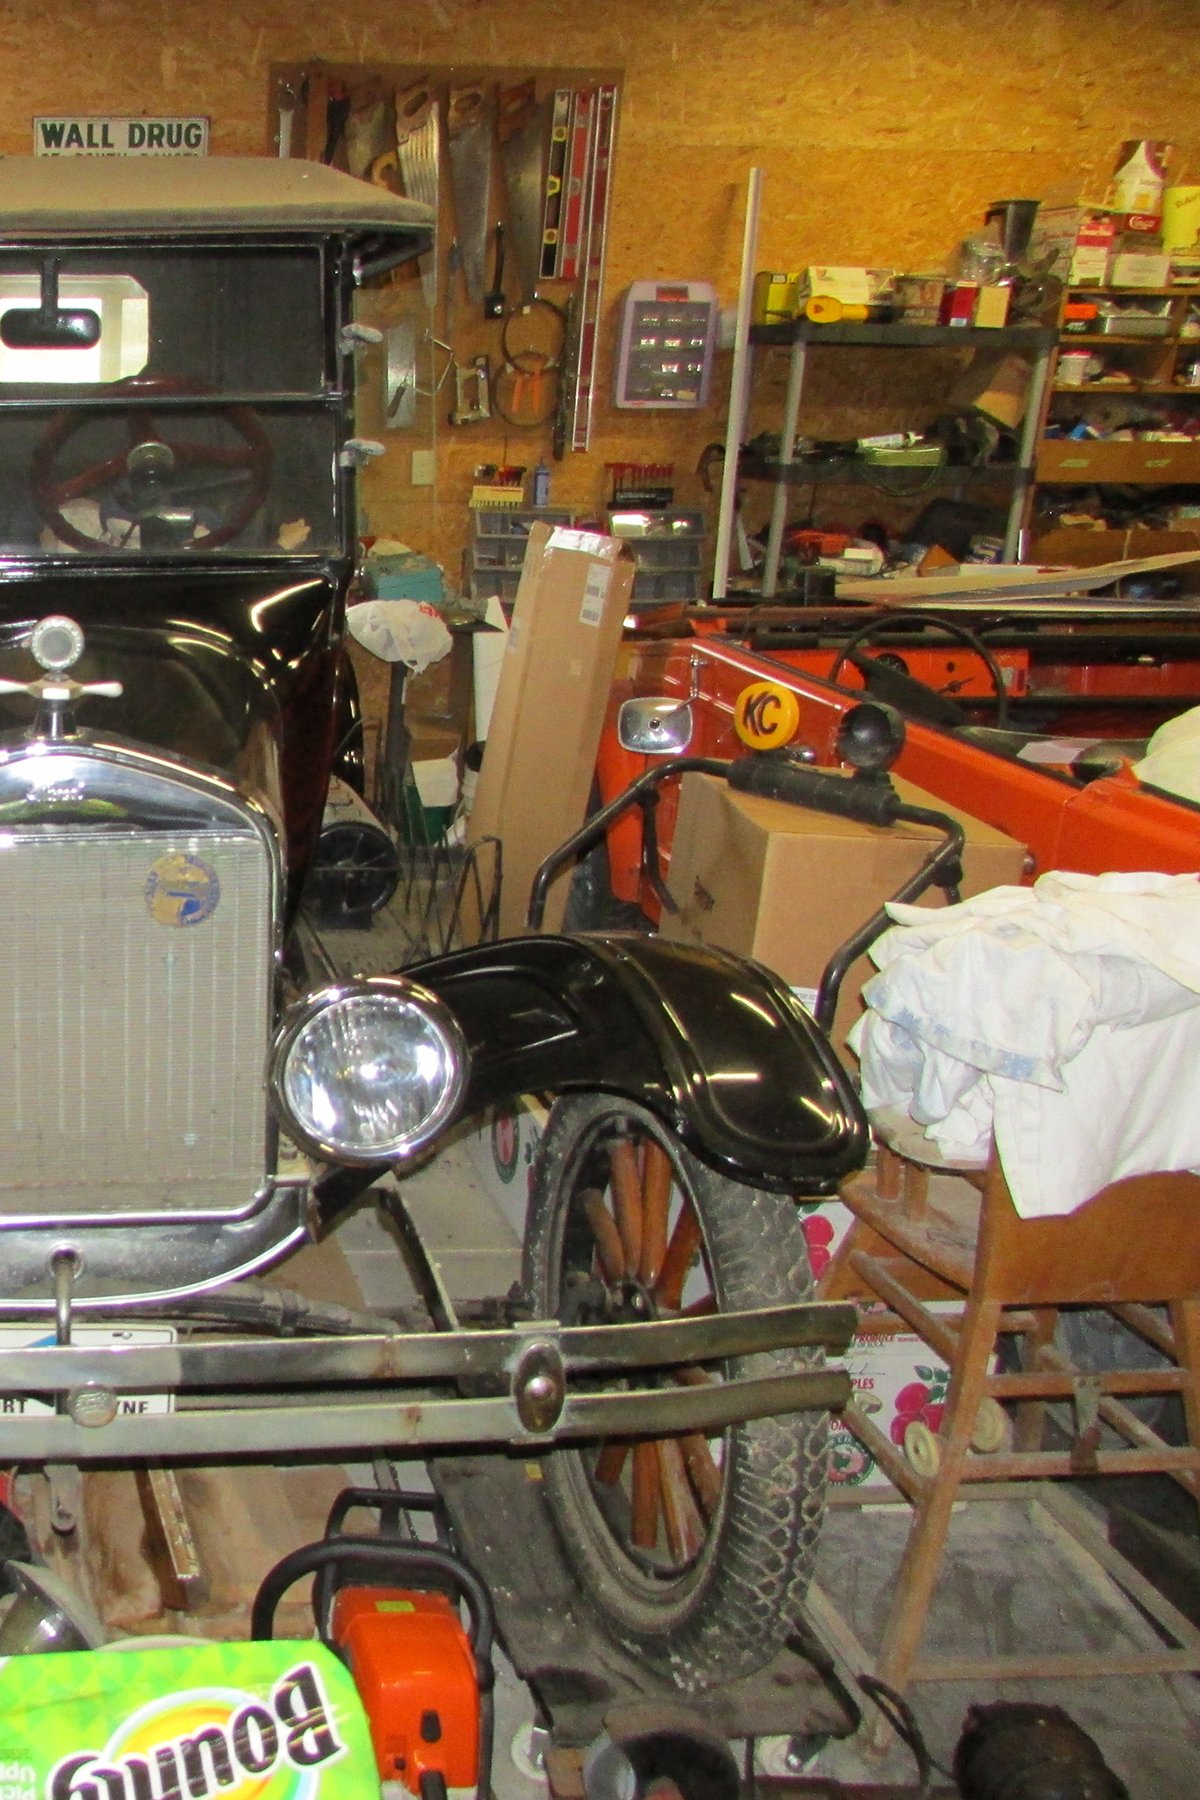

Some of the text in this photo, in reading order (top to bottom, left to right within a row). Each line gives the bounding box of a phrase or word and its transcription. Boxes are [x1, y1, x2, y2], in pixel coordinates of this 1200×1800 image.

[41, 122, 202, 148] WALL DRUG
[743, 690, 782, 737] KC
[852, 1378, 875, 1390] PLES
